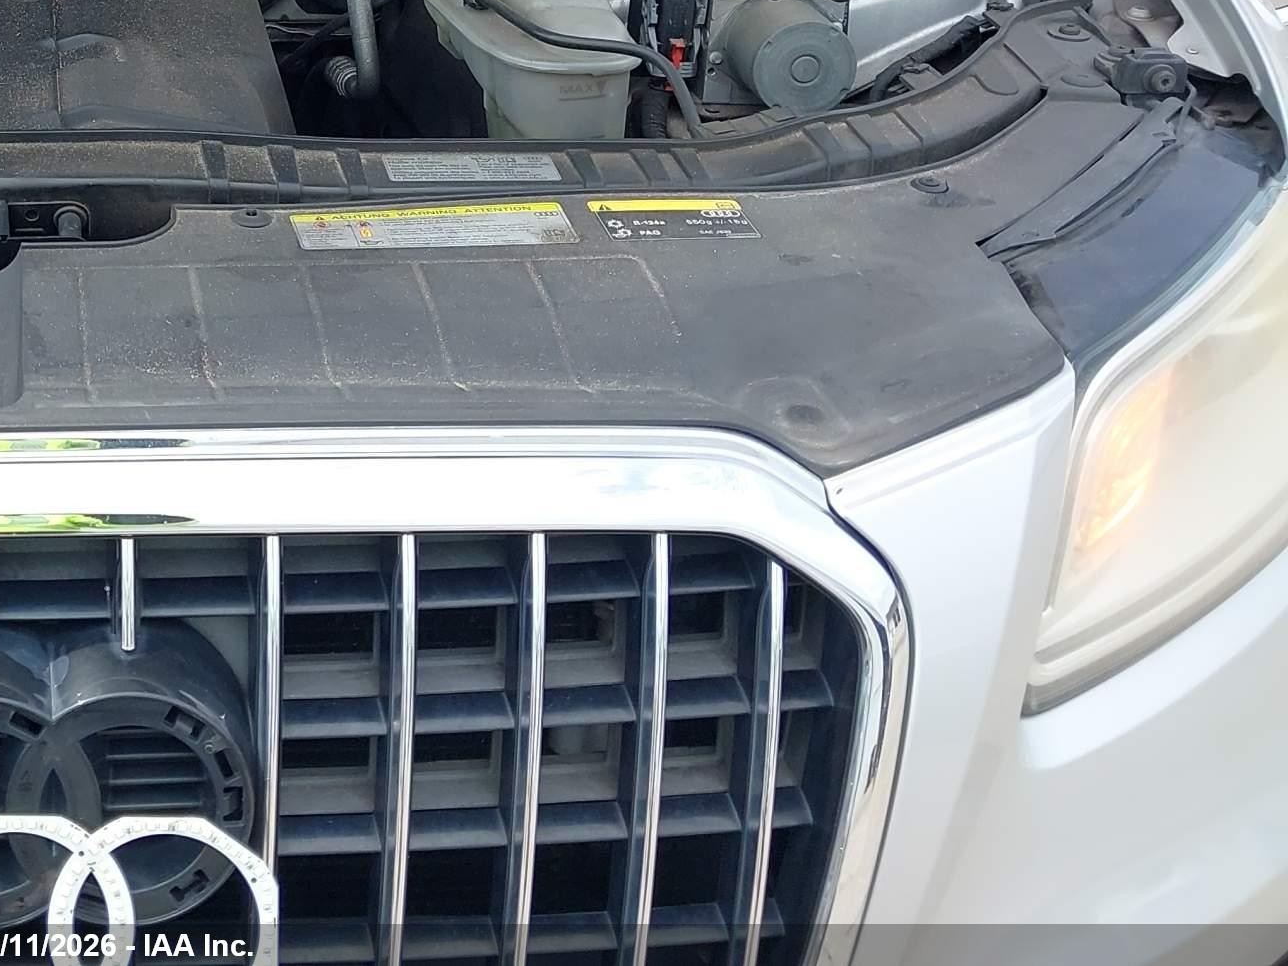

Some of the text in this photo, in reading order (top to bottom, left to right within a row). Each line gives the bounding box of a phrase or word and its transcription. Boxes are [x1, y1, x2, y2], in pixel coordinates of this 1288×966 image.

[559, 82, 593, 95] MAX
[331, 205, 532, 221] ACHTUNG WARNING ATTENTION
